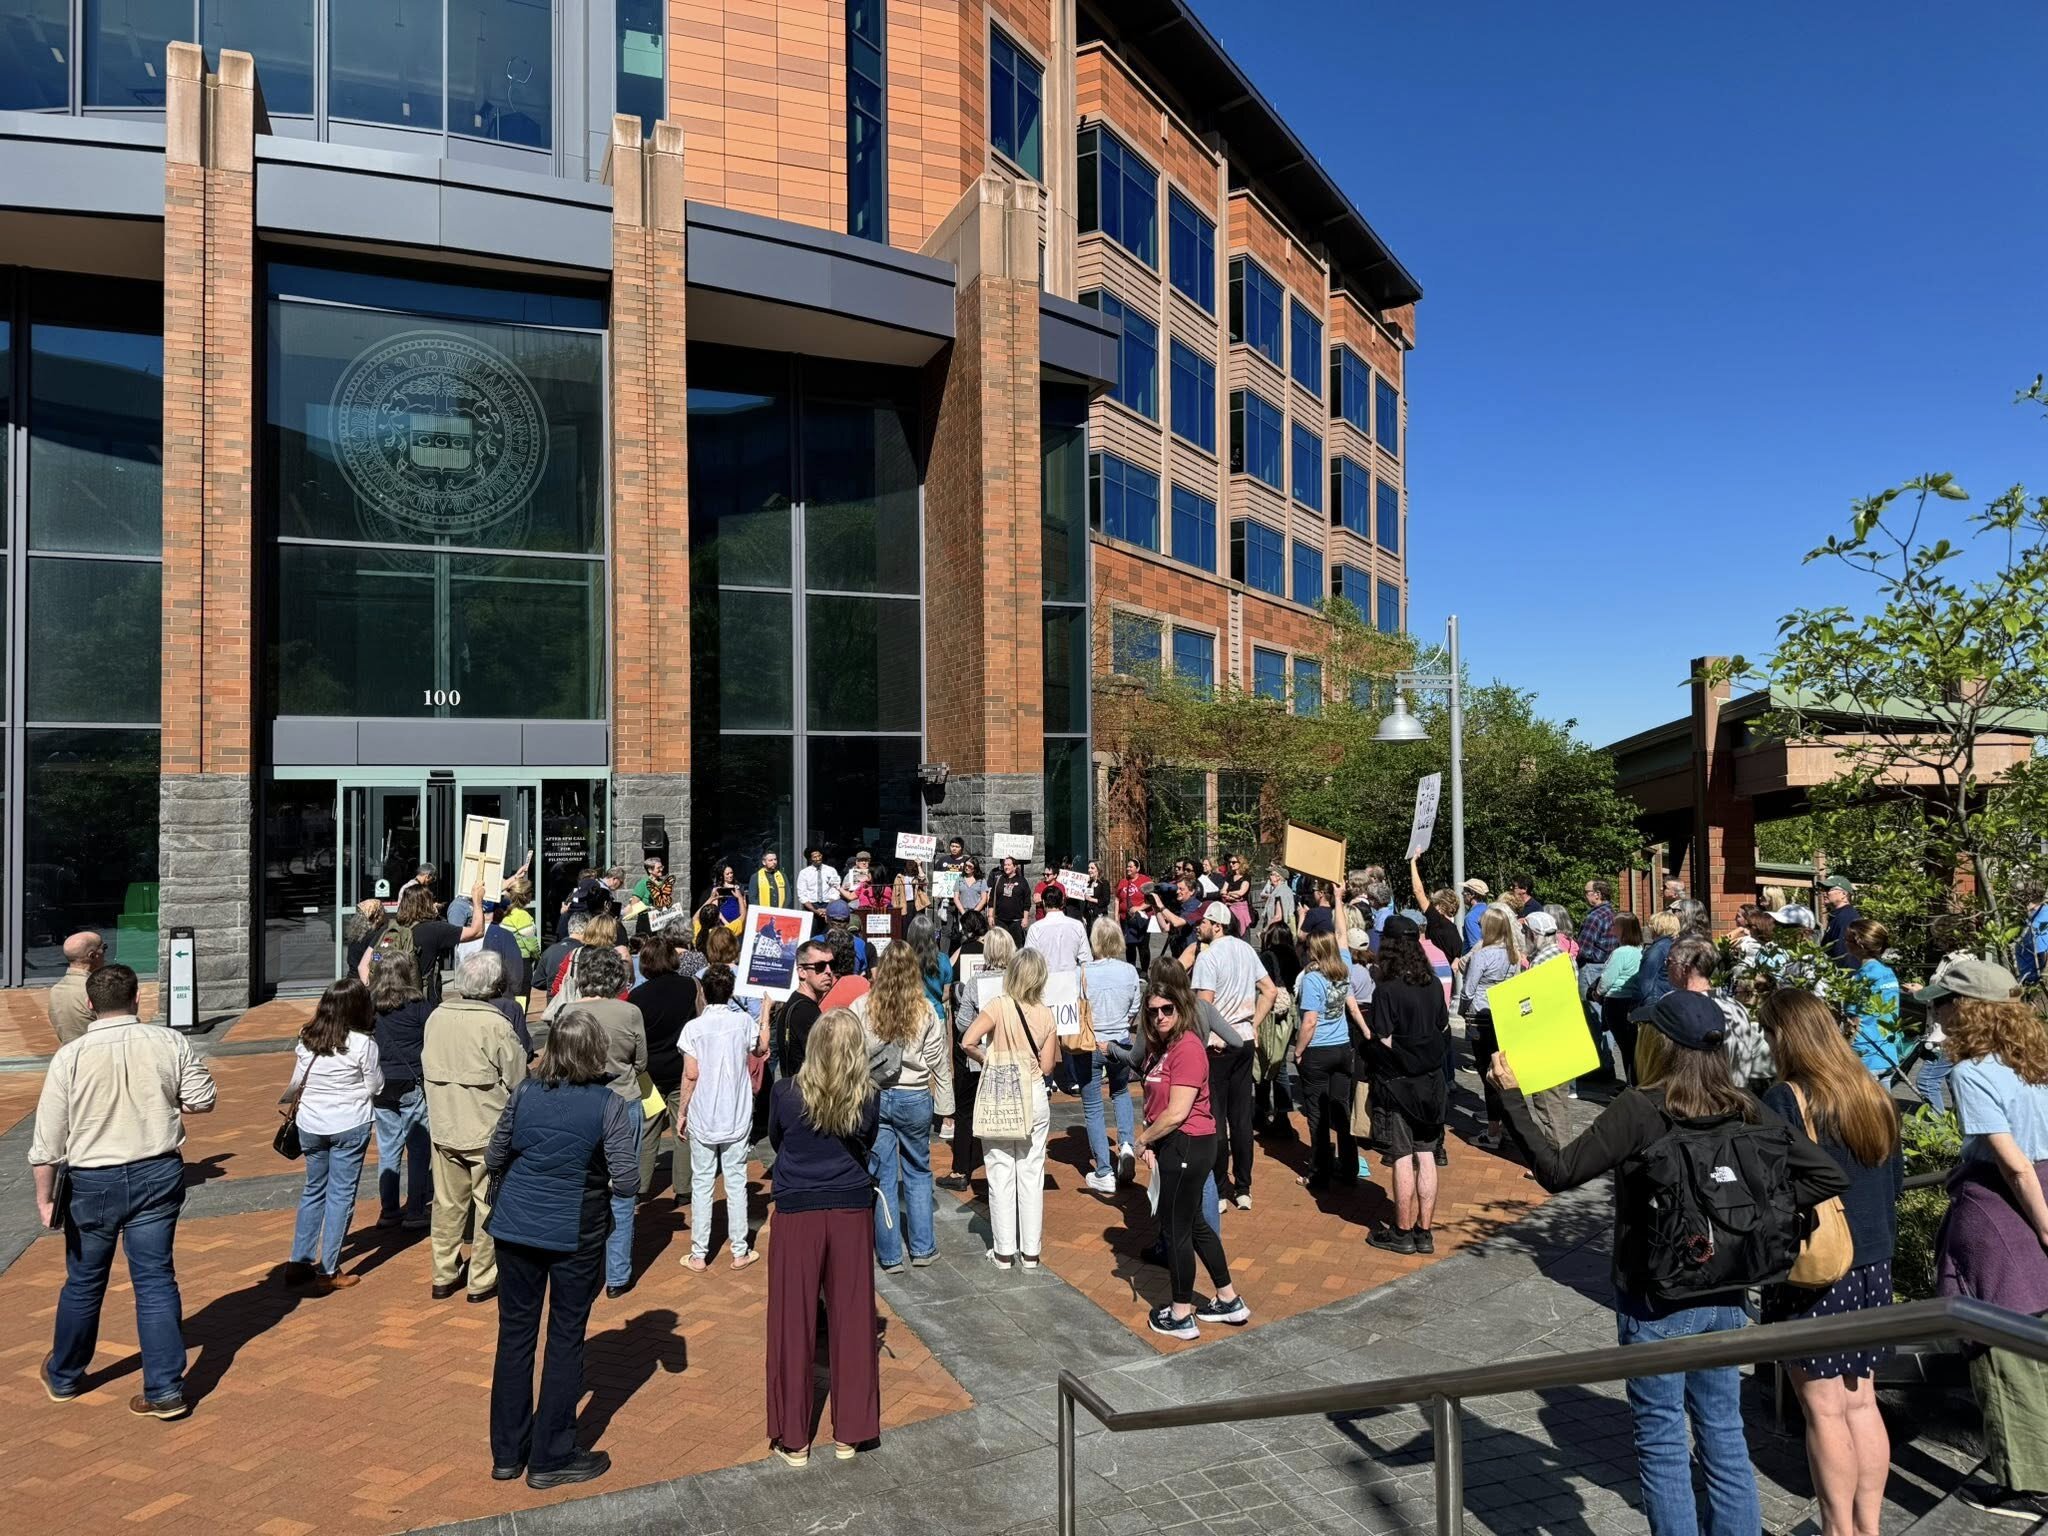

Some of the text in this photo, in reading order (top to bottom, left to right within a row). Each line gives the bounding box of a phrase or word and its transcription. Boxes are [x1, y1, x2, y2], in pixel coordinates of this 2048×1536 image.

[443, 351, 512, 399] WILLIAM
[503, 397, 529, 441] PENN
[410, 494, 448, 514] AND
[423, 690, 461, 706] 100
[902, 835, 933, 844] STOP
